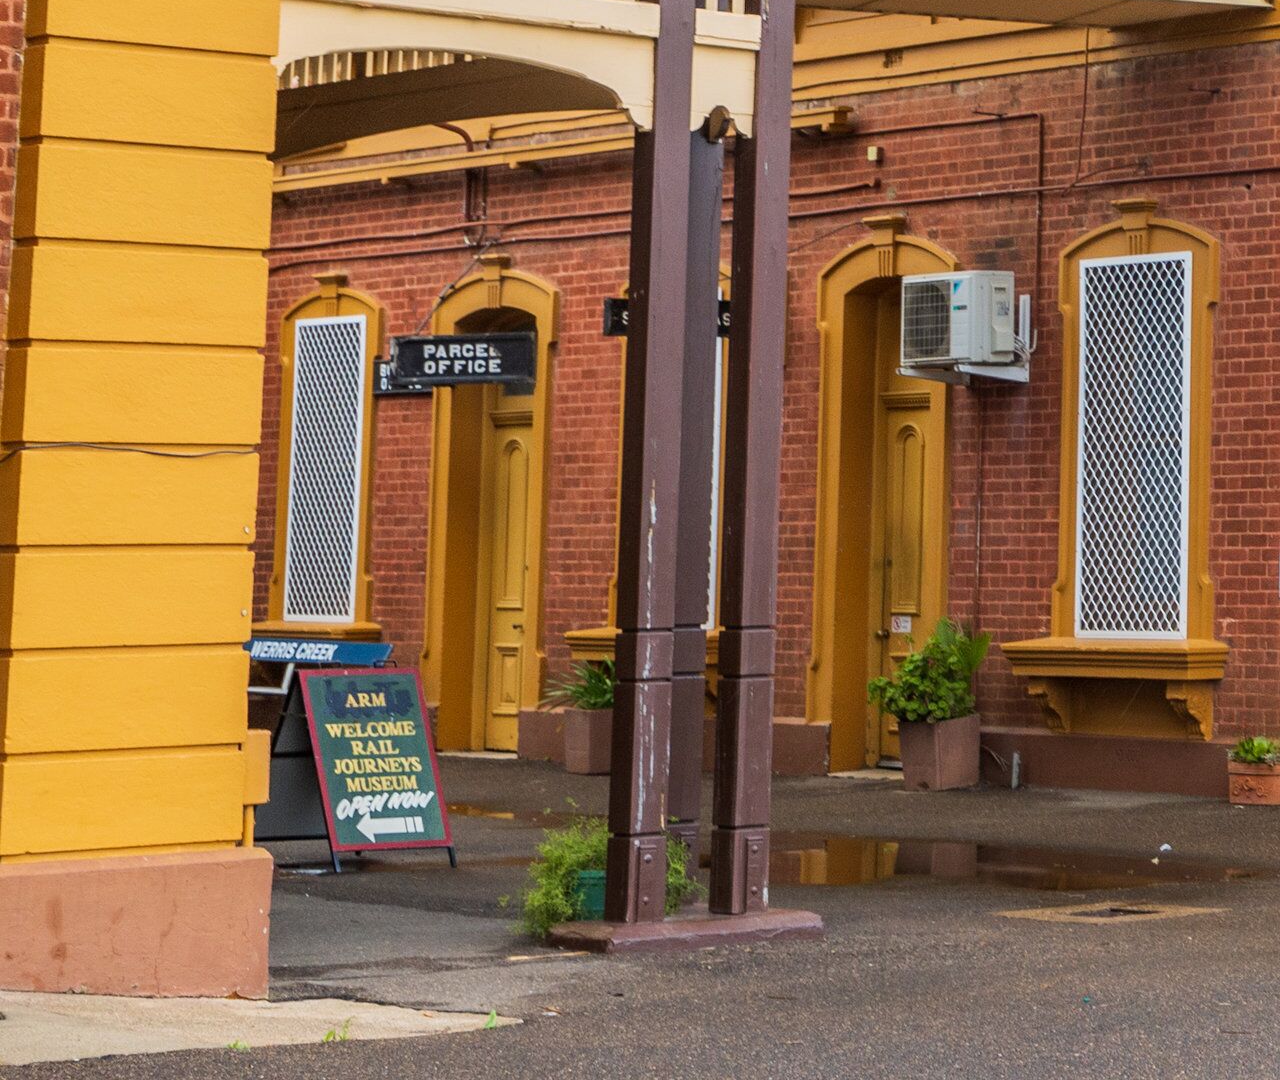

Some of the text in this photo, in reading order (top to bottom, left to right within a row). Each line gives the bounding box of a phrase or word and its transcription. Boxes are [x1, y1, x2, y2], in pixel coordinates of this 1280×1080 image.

[423, 359, 502, 375] OFFICE
[251, 640, 338, 661] WERRIS CREEK
[345, 692, 387, 708] ARM
[325, 721, 416, 738] WELCOME
[351, 740, 399, 756] RAIL
[334, 756, 423, 775] JOURNEYS
[345, 775, 418, 793] MUSEUM
[336, 790, 435, 820] OPEN NOW
